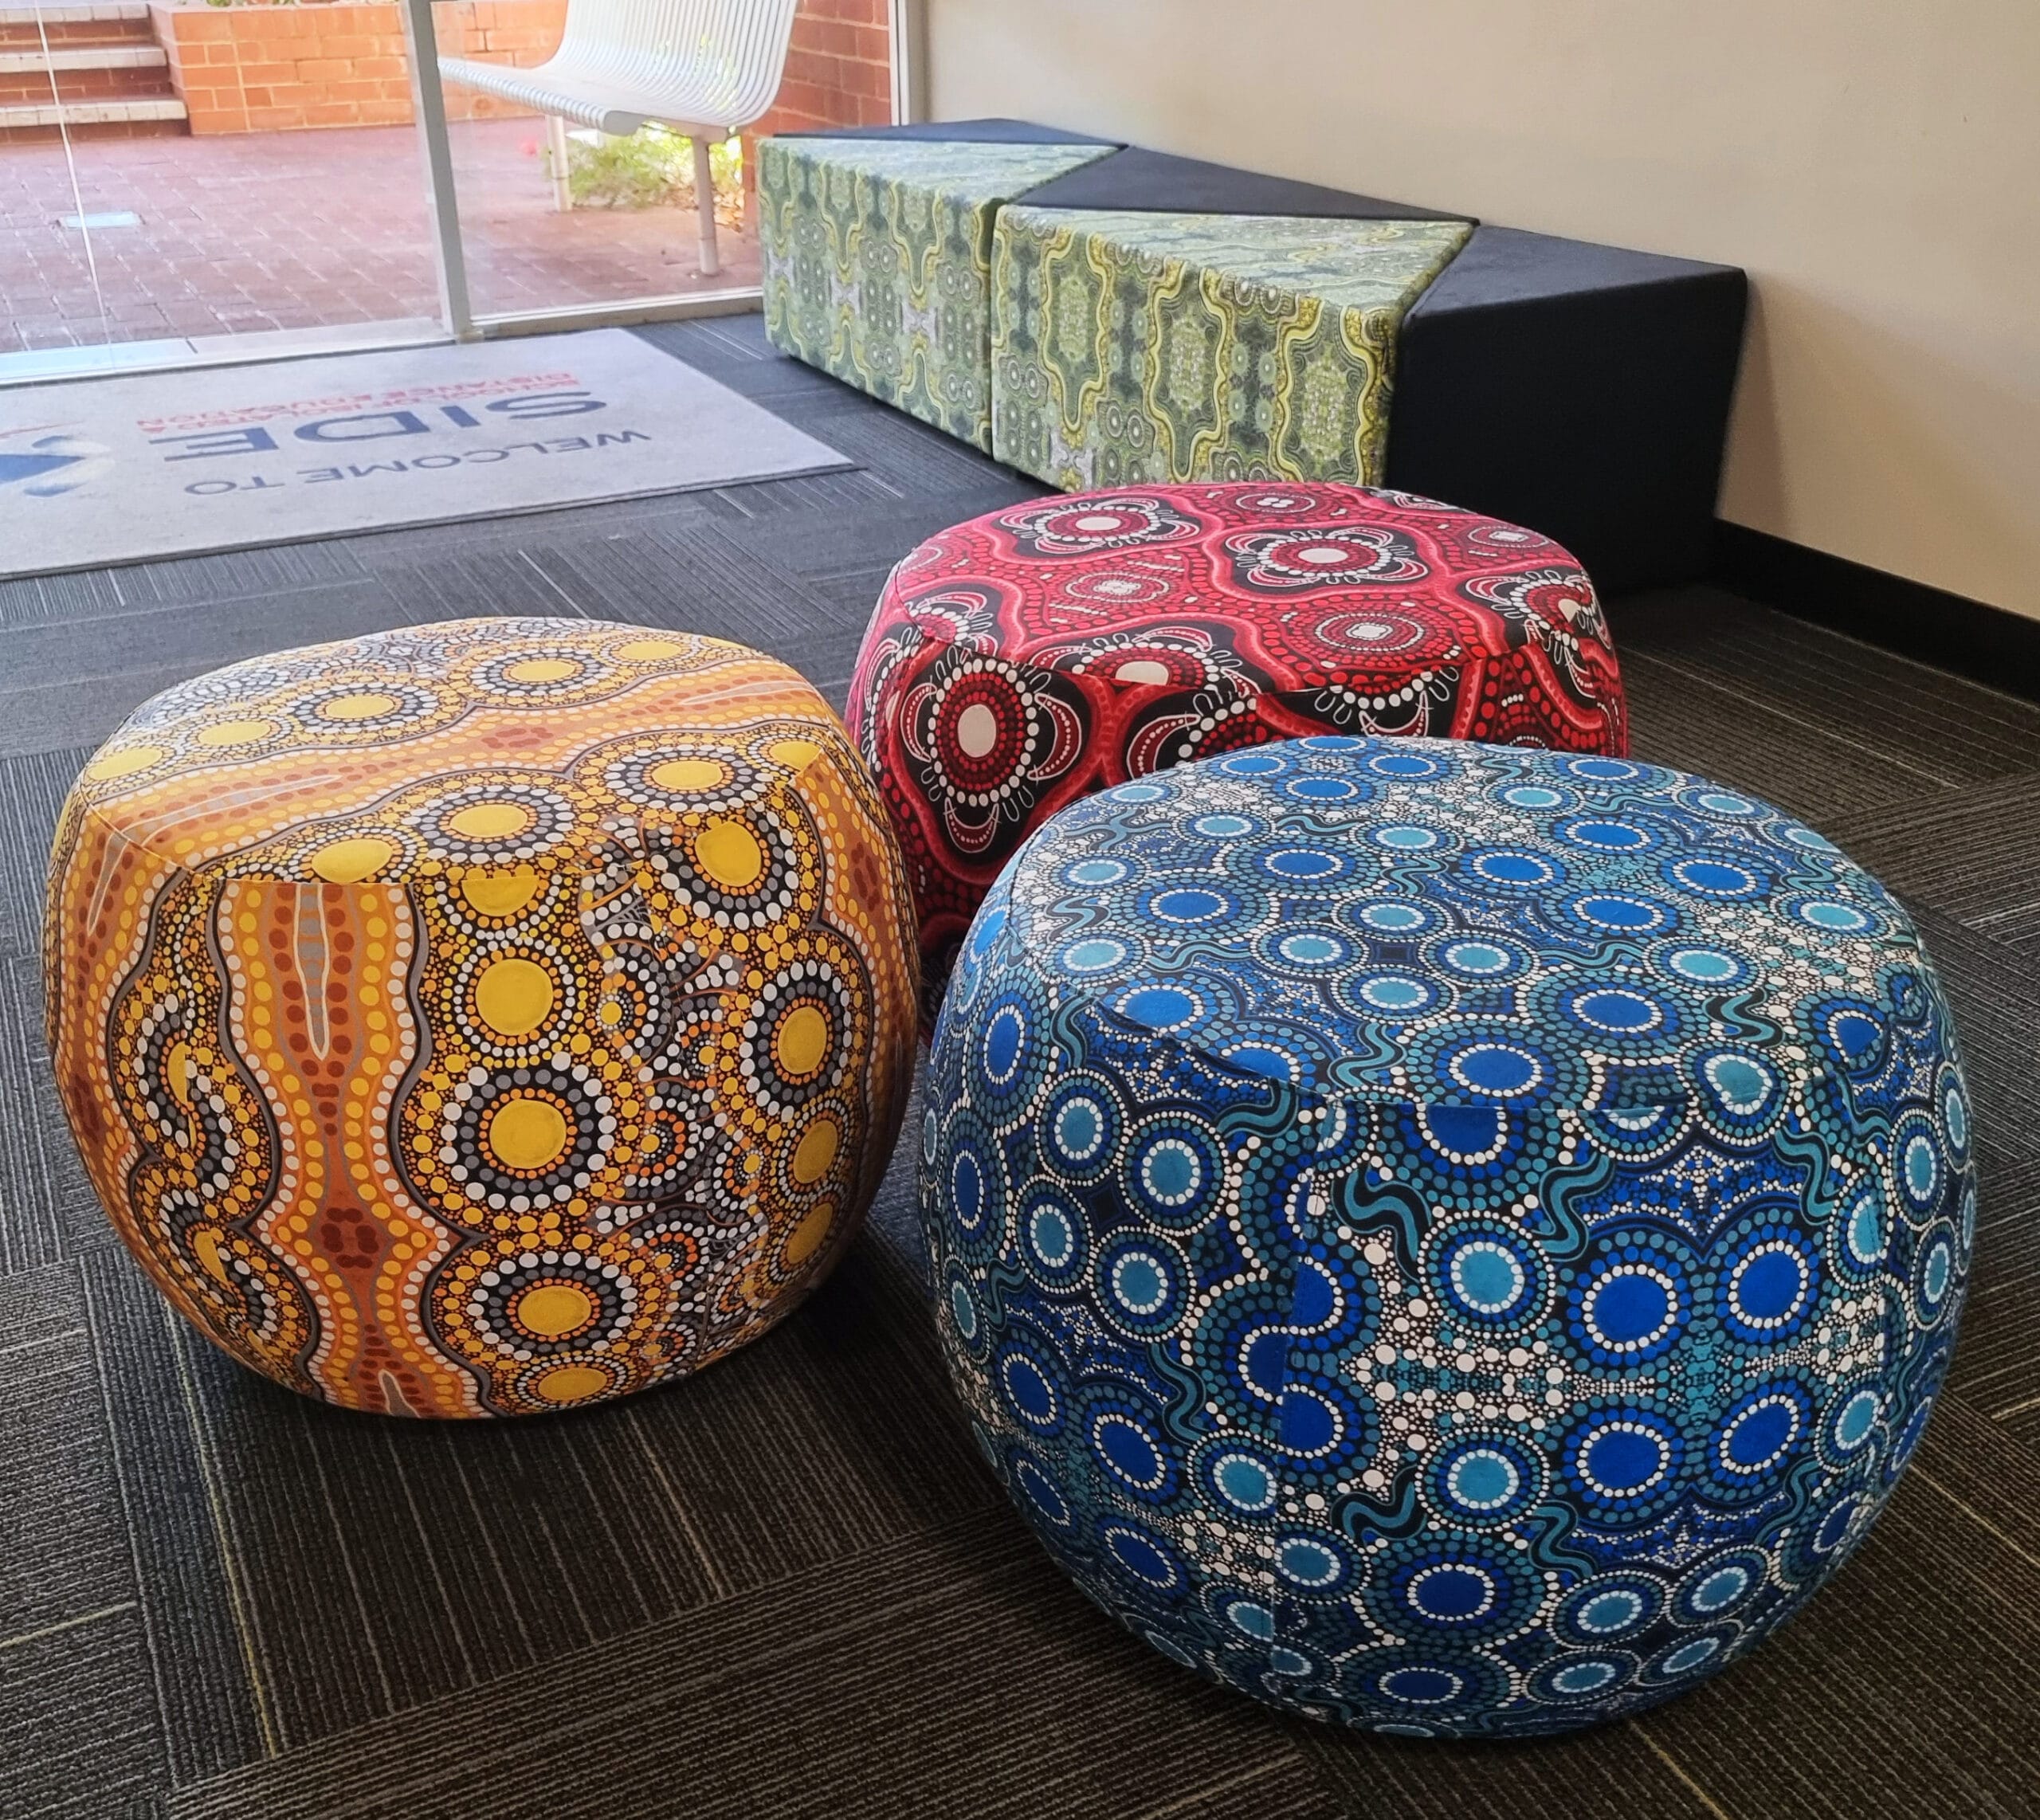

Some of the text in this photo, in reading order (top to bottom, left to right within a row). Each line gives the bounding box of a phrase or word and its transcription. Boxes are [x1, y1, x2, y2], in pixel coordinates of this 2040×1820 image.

[148, 391, 607, 461] SIDE
[184, 429, 652, 495] WELCOME TO
